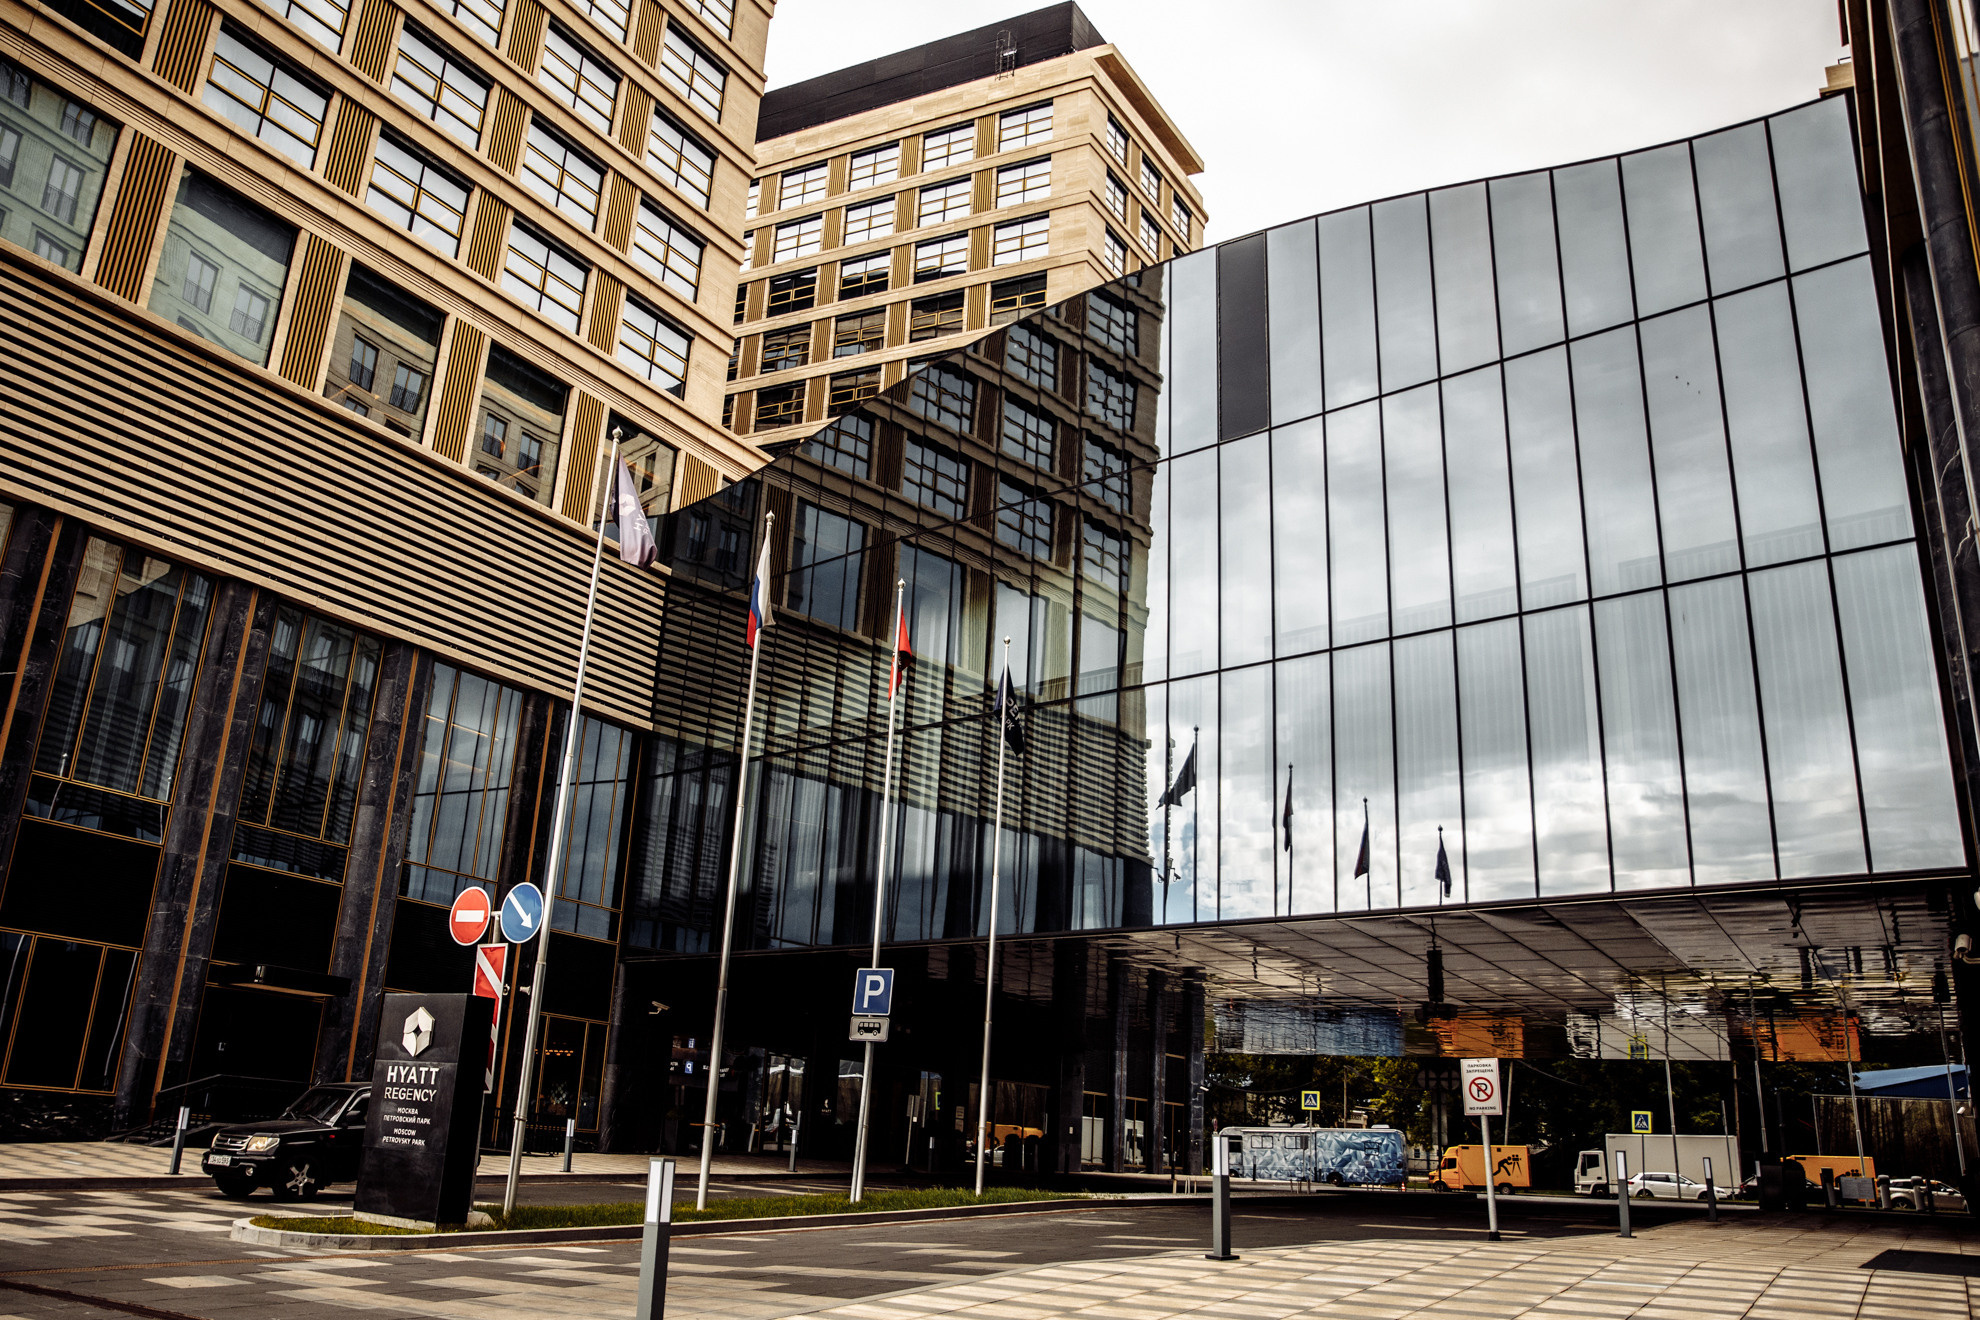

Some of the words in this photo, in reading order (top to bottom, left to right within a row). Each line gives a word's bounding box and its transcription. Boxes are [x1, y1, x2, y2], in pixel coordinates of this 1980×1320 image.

[862, 974, 885, 1009] P
[386, 1065, 440, 1085] HYATT
[384, 1086, 437, 1102] REGENCY
[397, 1107, 419, 1115] МОСКВА
[383, 1114, 416, 1124] ПЕТРОВСКИЙ
[416, 1117, 431, 1125] ПАРК
[393, 1128, 417, 1136] MOSCOW
[382, 1135, 412, 1145] PETROVSKY
[411, 1138, 426, 1147] PARK
